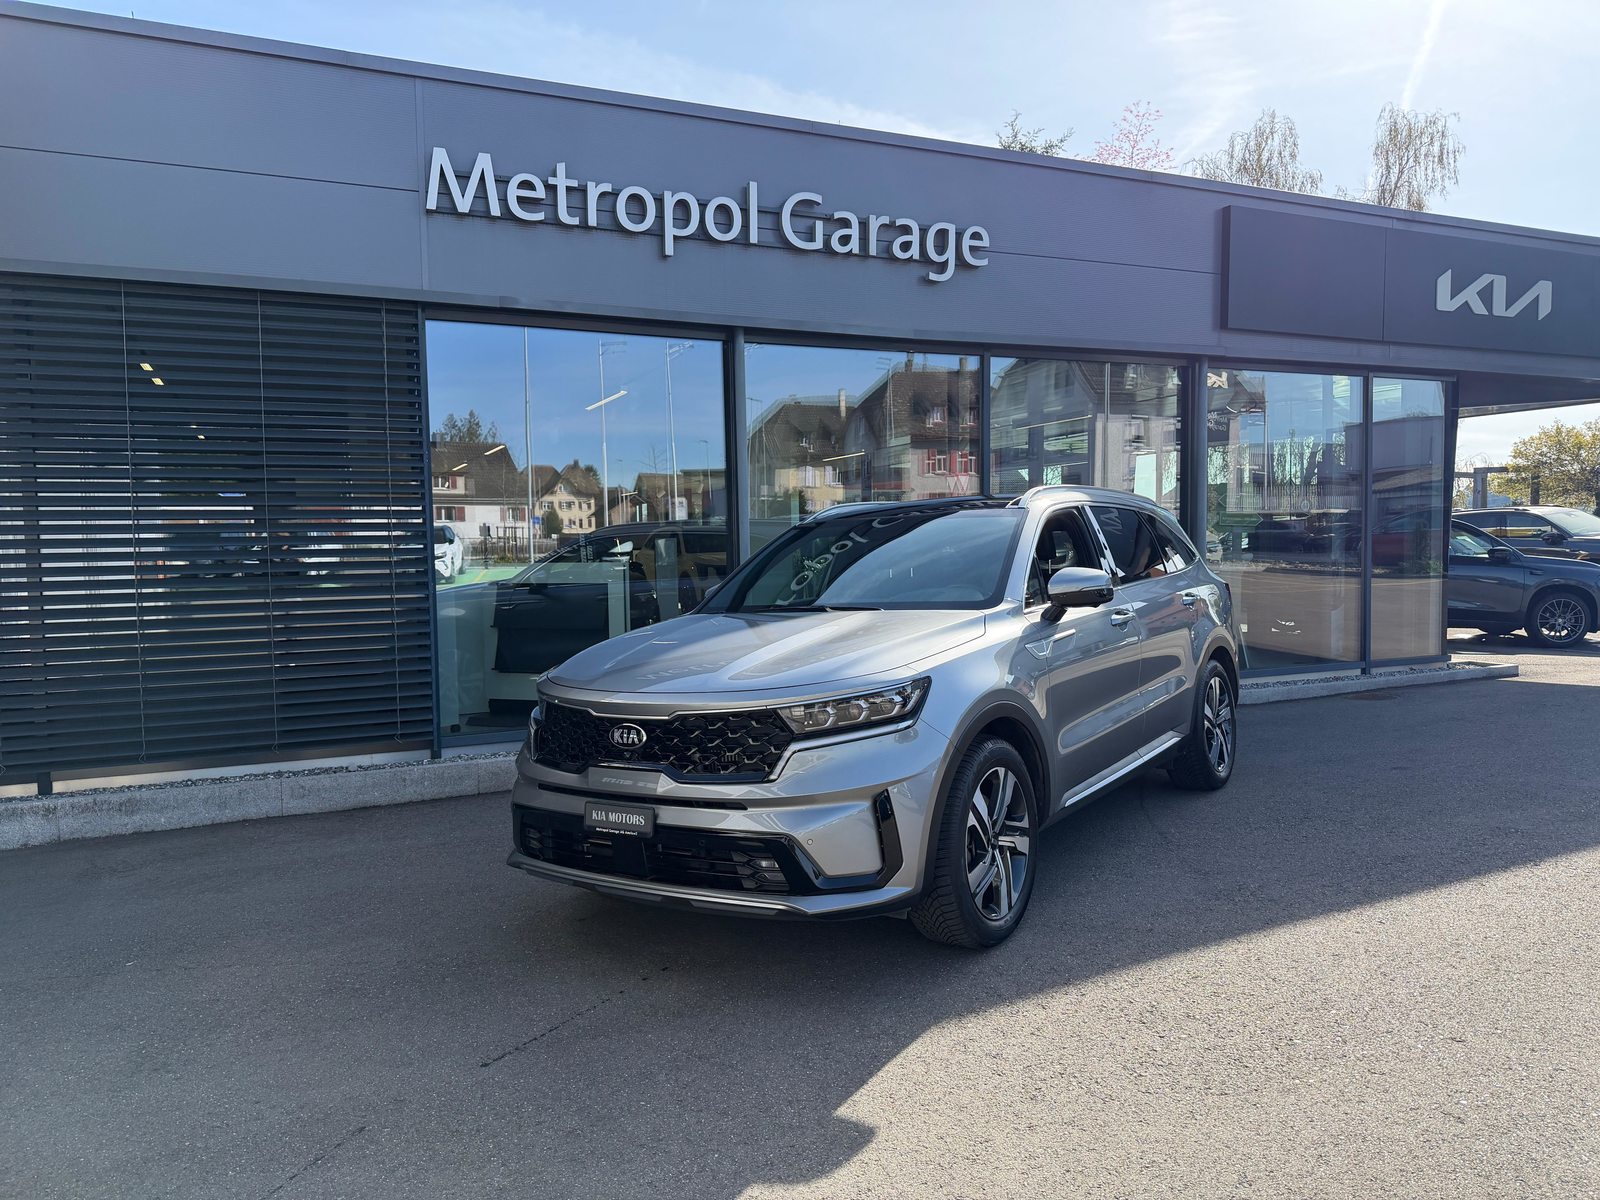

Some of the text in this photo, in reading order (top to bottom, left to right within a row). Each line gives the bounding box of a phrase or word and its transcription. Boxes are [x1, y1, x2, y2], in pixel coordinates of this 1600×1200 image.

[426, 146, 990, 282] Metropol Garage
[613, 729, 640, 744] KIA
[592, 810, 645, 826] KIA MOTORS
